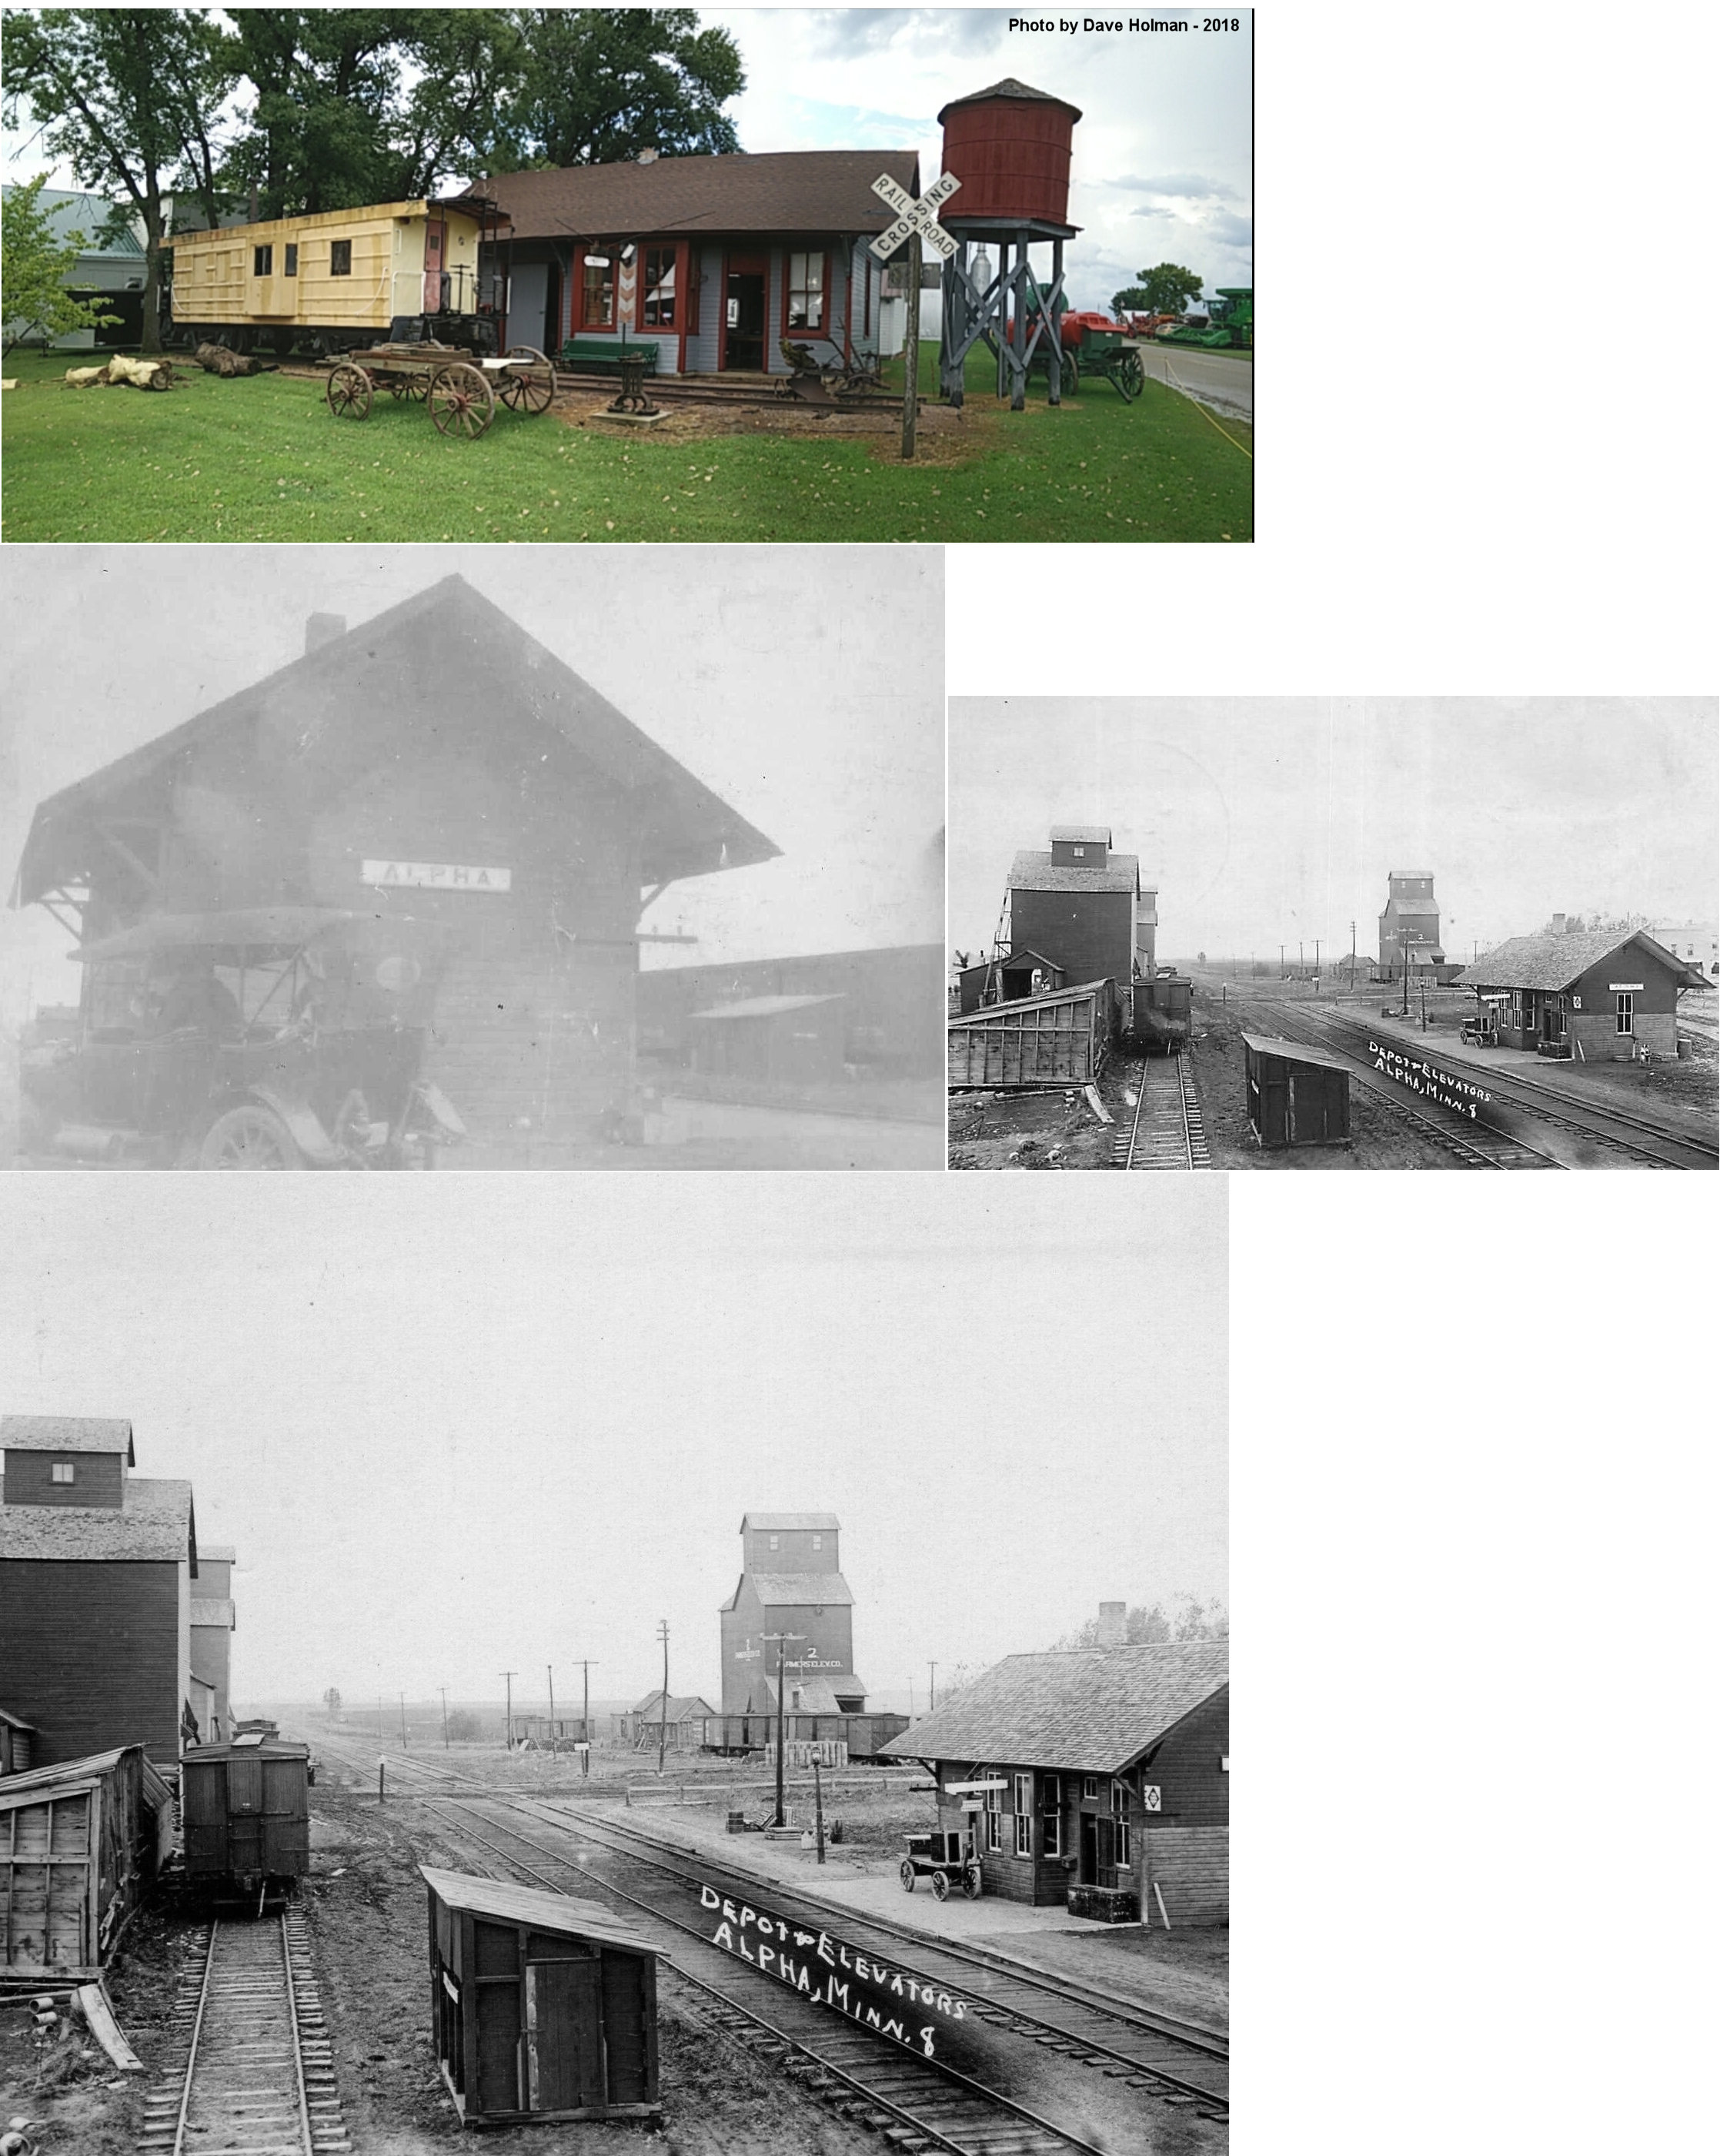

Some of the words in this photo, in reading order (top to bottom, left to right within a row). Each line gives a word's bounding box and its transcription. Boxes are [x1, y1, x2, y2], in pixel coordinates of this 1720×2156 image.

[876, 178, 907, 210] RAIL
[920, 221, 954, 254] ROAD
[877, 179, 953, 251] CROSSING
[384, 863, 492, 886] ALPHA
[1369, 1041, 1410, 1068] DEPOT
[1421, 1062, 1491, 1102] ELEVATORS
[1374, 1058, 1424, 1094] ALPHA,
[1426, 1081, 1466, 1112] MINN.
[700, 1886, 789, 1941] DEPOT
[817, 1932, 967, 2020] ELEVATORS
[712, 1922, 820, 2002] ALPHA,
[827, 1974, 911, 2044] MINN.
